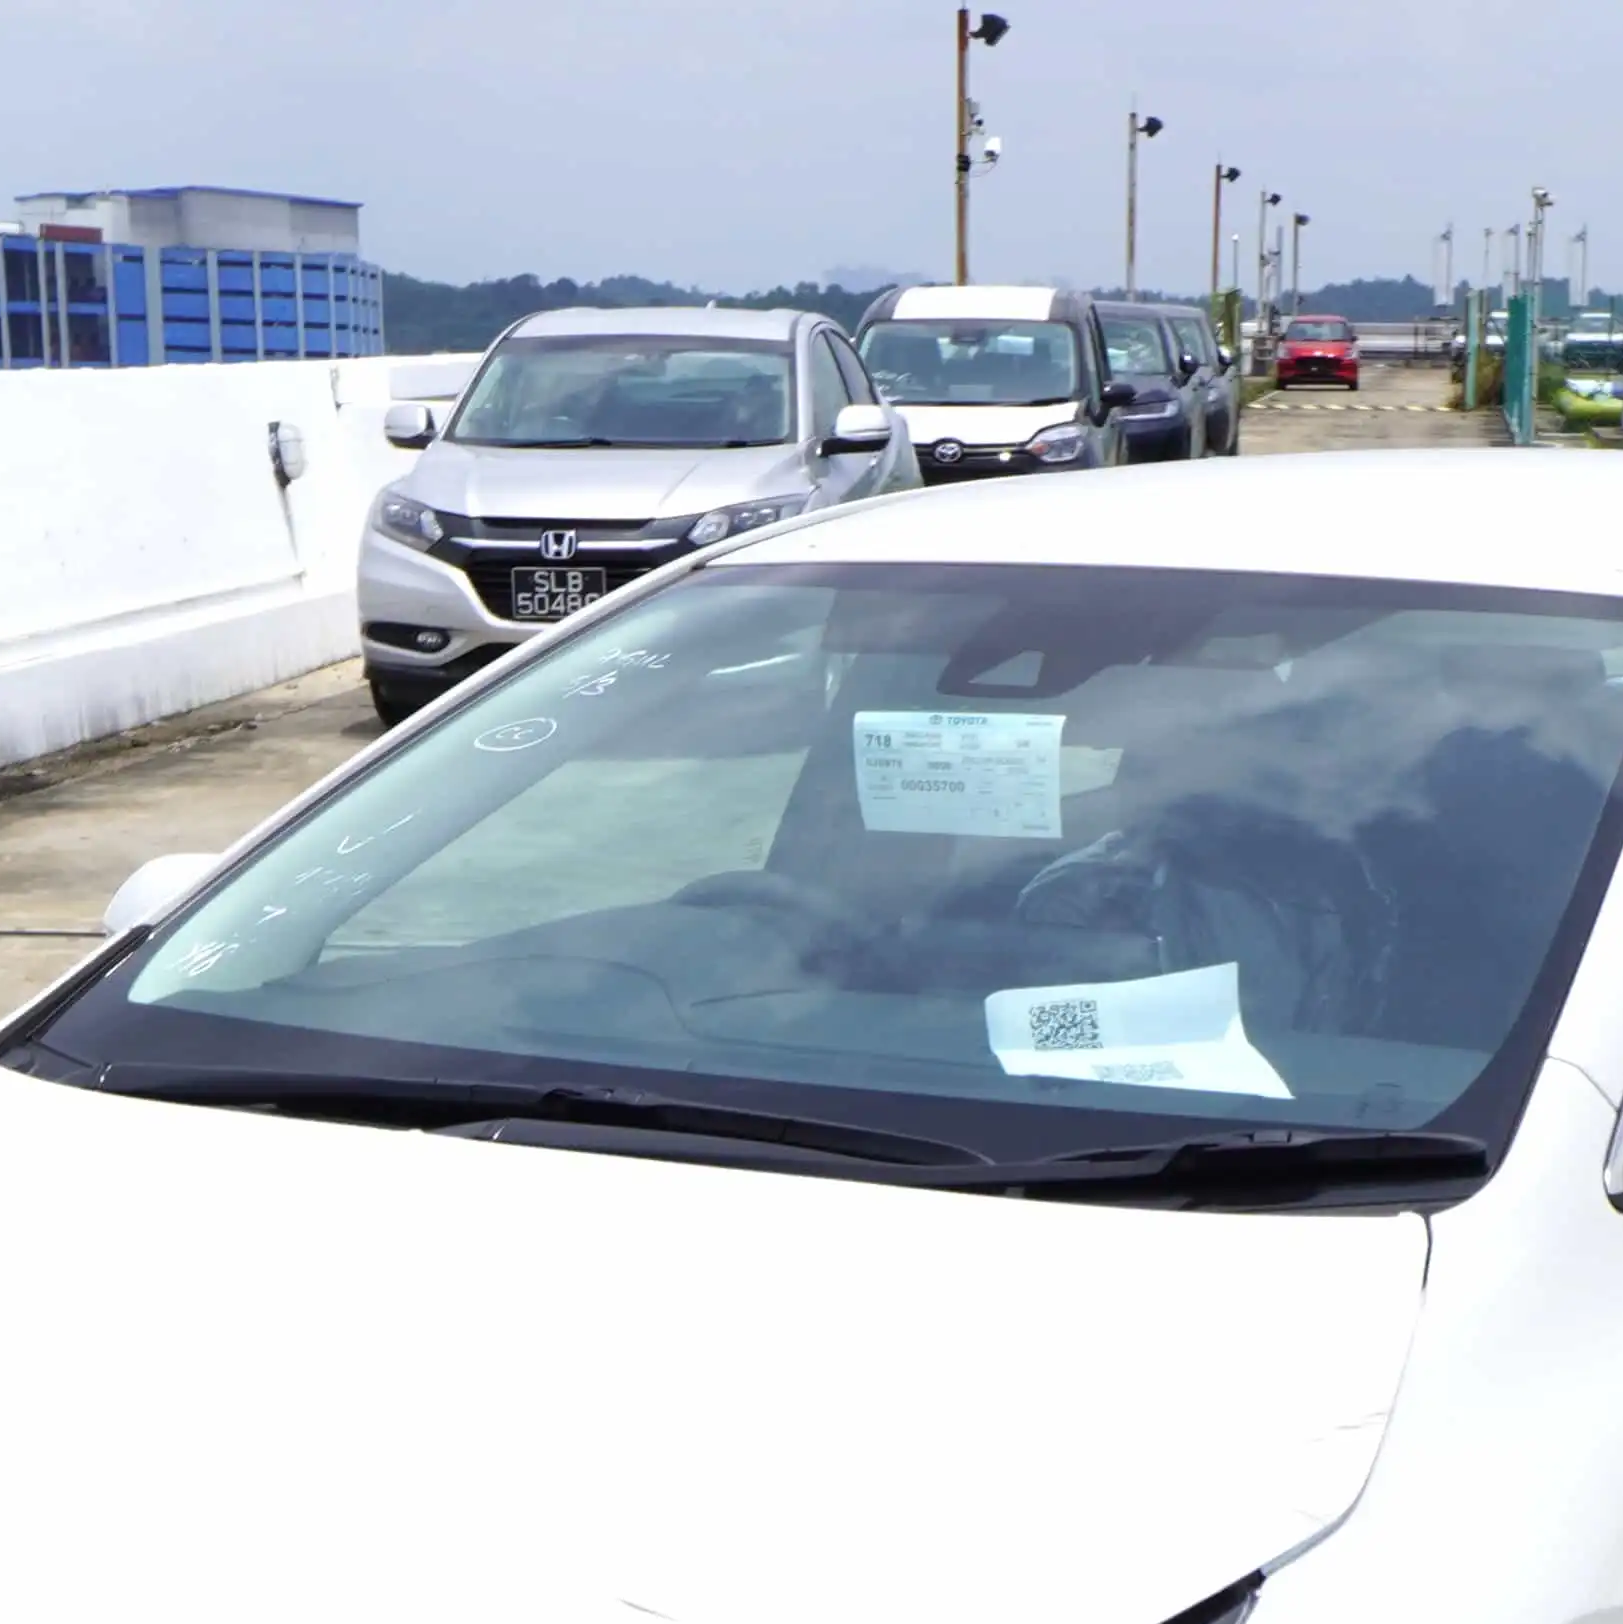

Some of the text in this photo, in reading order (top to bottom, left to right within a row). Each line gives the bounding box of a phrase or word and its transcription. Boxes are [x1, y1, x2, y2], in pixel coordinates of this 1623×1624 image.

[534, 571, 583, 593] SLB
[947, 716, 989, 726] TOYOTA
[864, 733, 892, 748] 718
